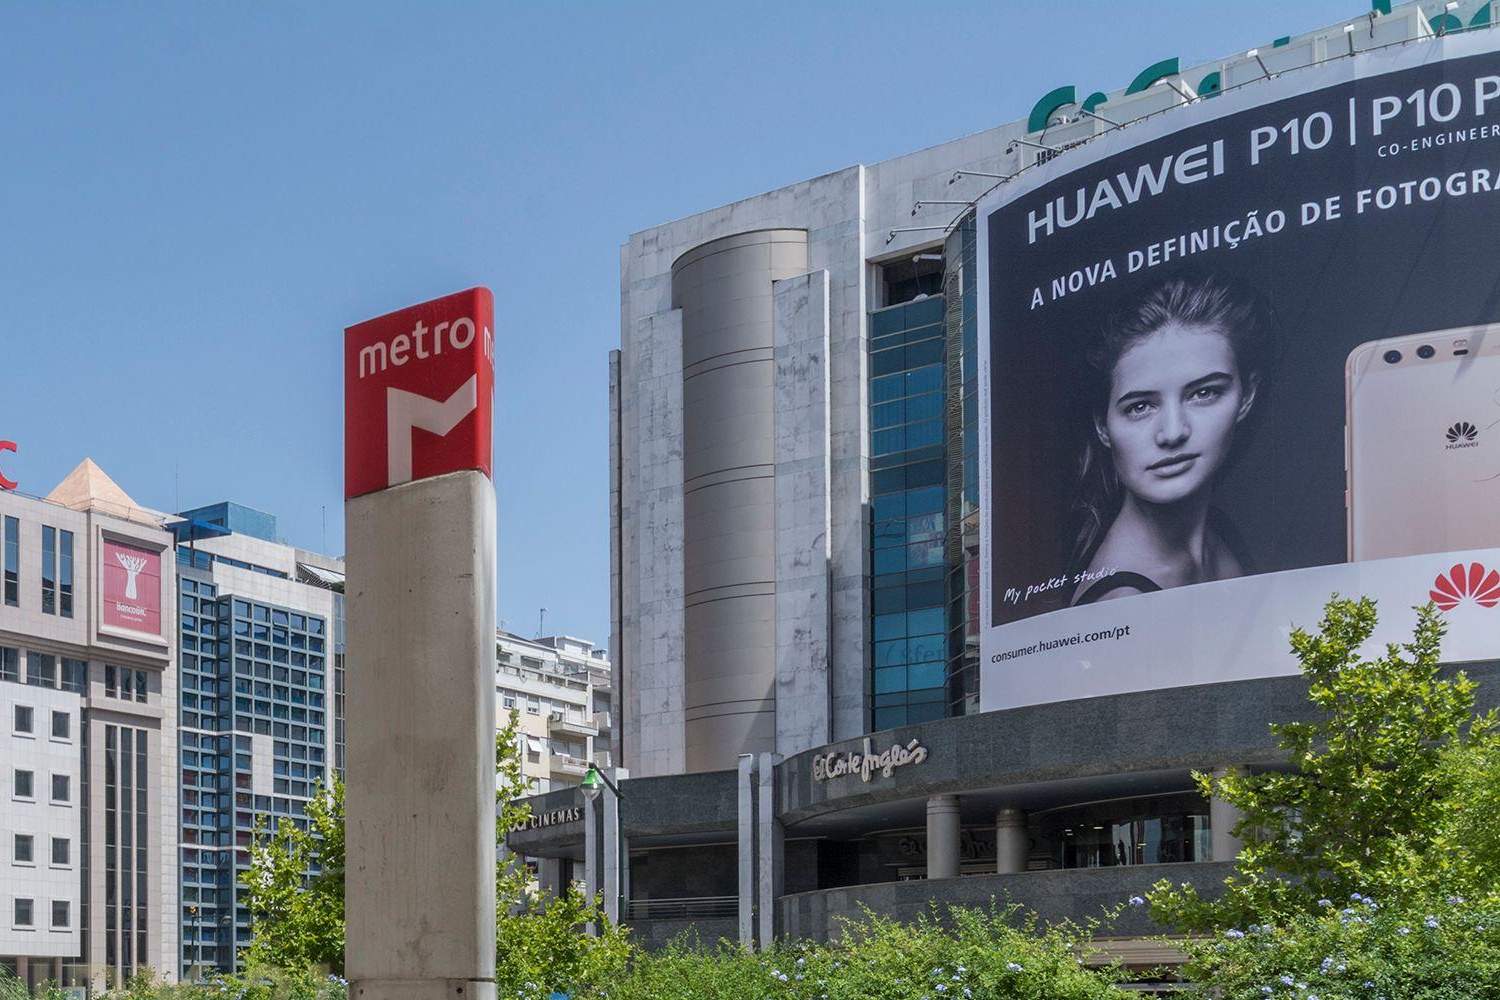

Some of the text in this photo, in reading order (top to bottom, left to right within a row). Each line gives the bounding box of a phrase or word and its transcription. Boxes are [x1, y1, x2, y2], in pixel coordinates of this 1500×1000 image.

[1028, 139, 1225, 245] HUAWEI
[1251, 111, 1334, 166] P10
[1372, 82, 1462, 136] P10
[1030, 168, 1500, 310] A NOVA DEFINIÇÃO DE FOTOGR
[359, 316, 476, 379] metro
[1003, 566, 1117, 605] My pocket studio
[991, 625, 1131, 663] consumer.huawei.com/pt
[531, 807, 580, 828] CINEMAS
